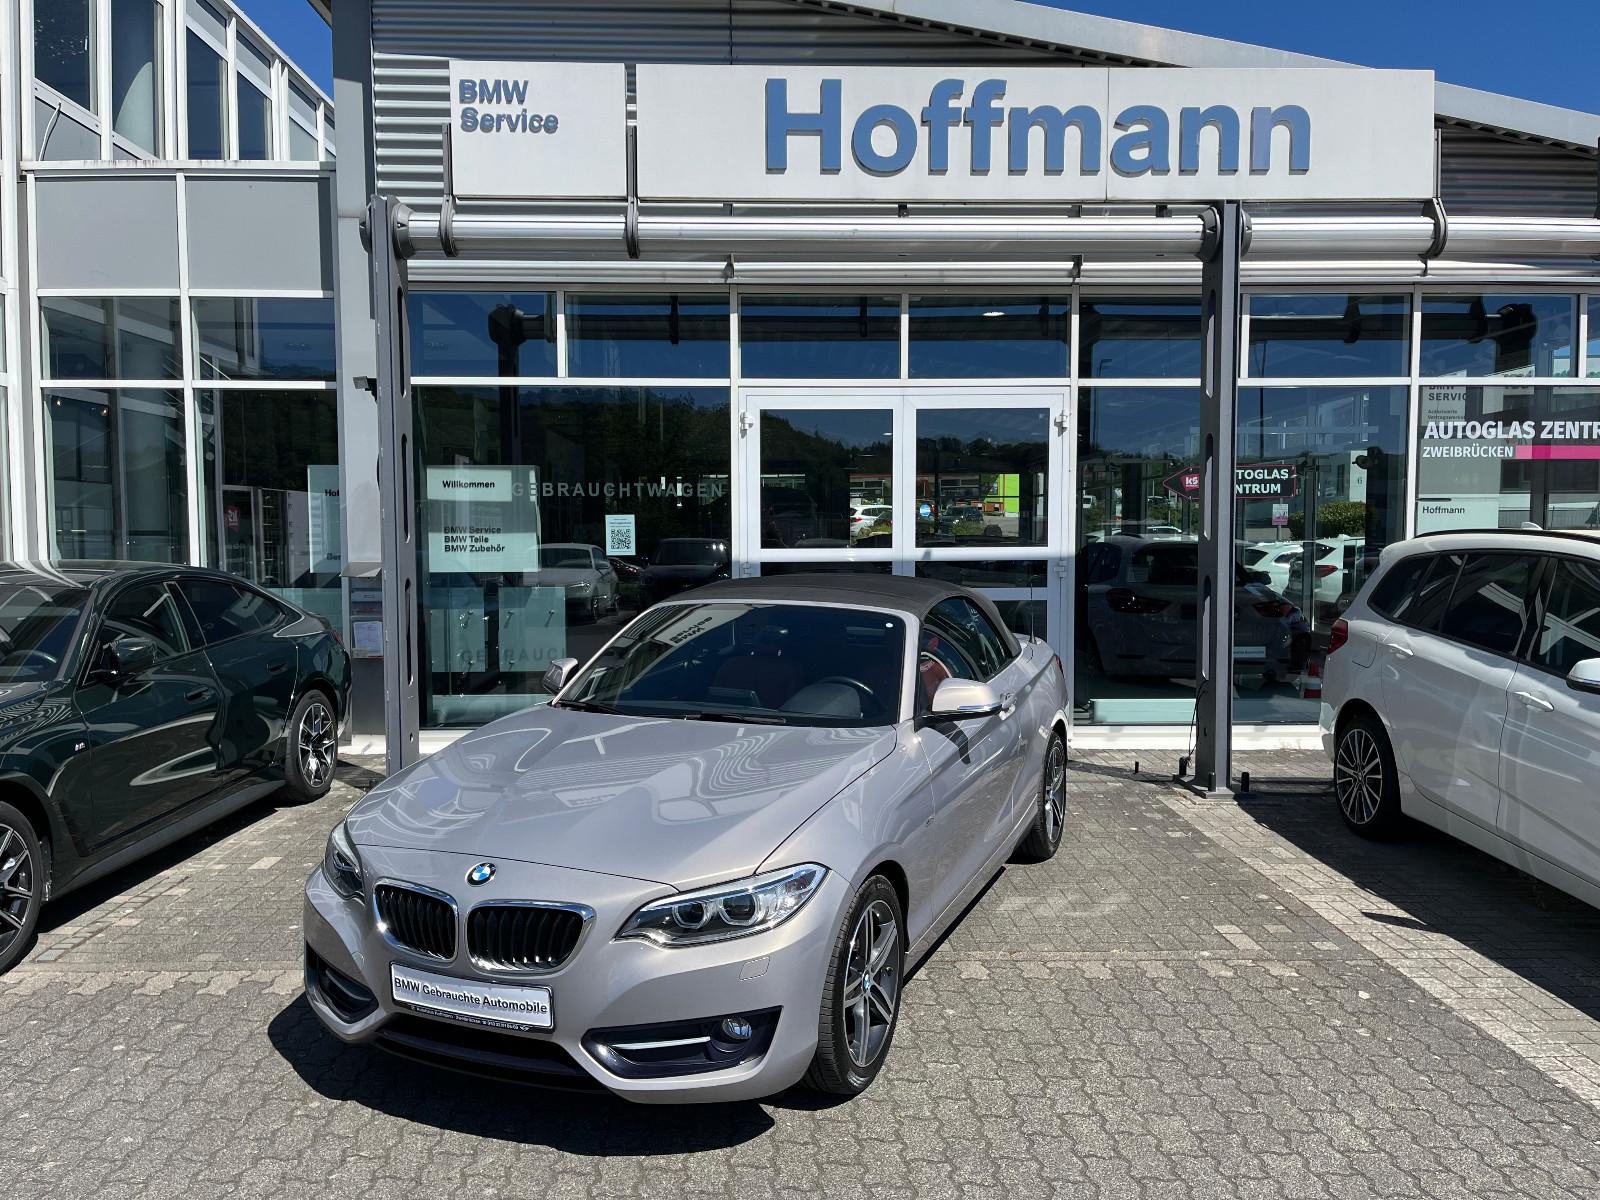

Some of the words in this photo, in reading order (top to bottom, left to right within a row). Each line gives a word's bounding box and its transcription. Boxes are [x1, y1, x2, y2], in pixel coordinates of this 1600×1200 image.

[458, 79, 529, 105] BMW
[460, 106, 559, 133] Service
[765, 78, 1312, 176] Hoffmann
[1424, 421, 1536, 439] AUTOGLAS
[1422, 443, 1514, 458] ZWEIBRÜCKEN
[1235, 469, 1289, 480] TOGLAS
[442, 479, 496, 489] Willkommen
[512, 482, 724, 499] GEBRAUCHTWAGEN
[1235, 483, 1281, 494] NTRUM
[1422, 505, 1466, 515] Hoffmann
[444, 525, 467, 535] BMW
[469, 525, 502, 535] Service
[444, 535, 467, 543] BMW
[469, 534, 490, 543] Teile
[444, 544, 467, 553] BMW
[469, 543, 505, 553] Zubehör
[394, 976, 421, 993] BMW
[422, 984, 481, 1005] Gebrauchte
[483, 996, 548, 1013] Automobile
